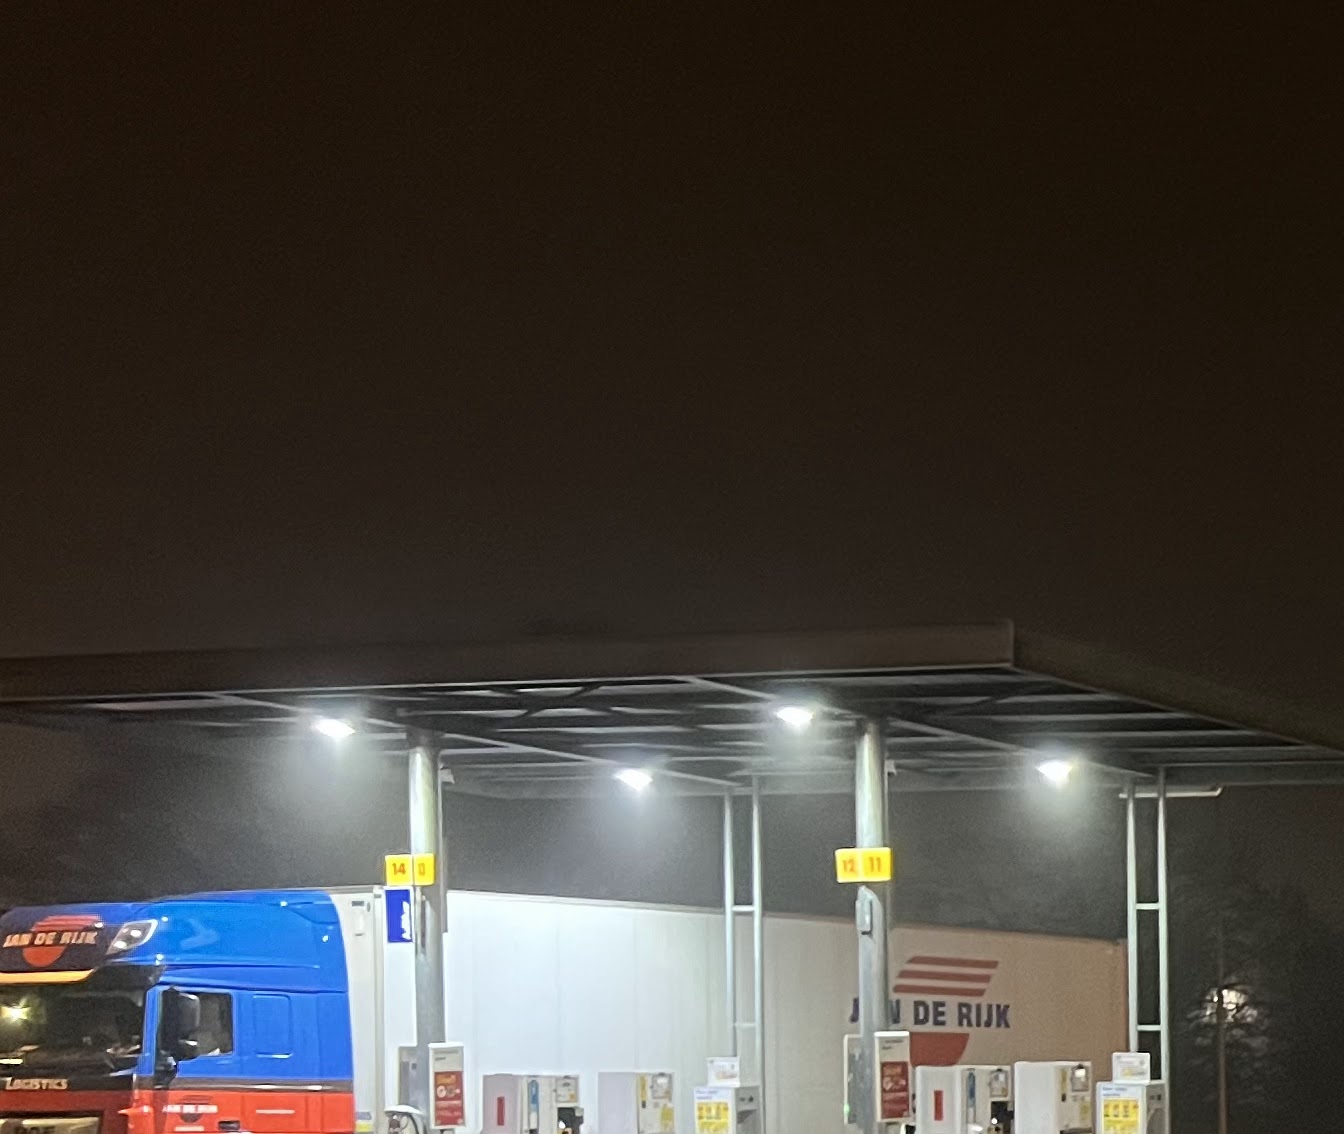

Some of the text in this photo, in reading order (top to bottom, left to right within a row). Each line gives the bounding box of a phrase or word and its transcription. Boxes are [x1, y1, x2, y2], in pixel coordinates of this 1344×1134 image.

[392, 863, 406, 876] 14
[2, 931, 98, 948] JAN DE RIJK
[913, 1000, 947, 1026] DE
[957, 1002, 1011, 1029] RIJK
